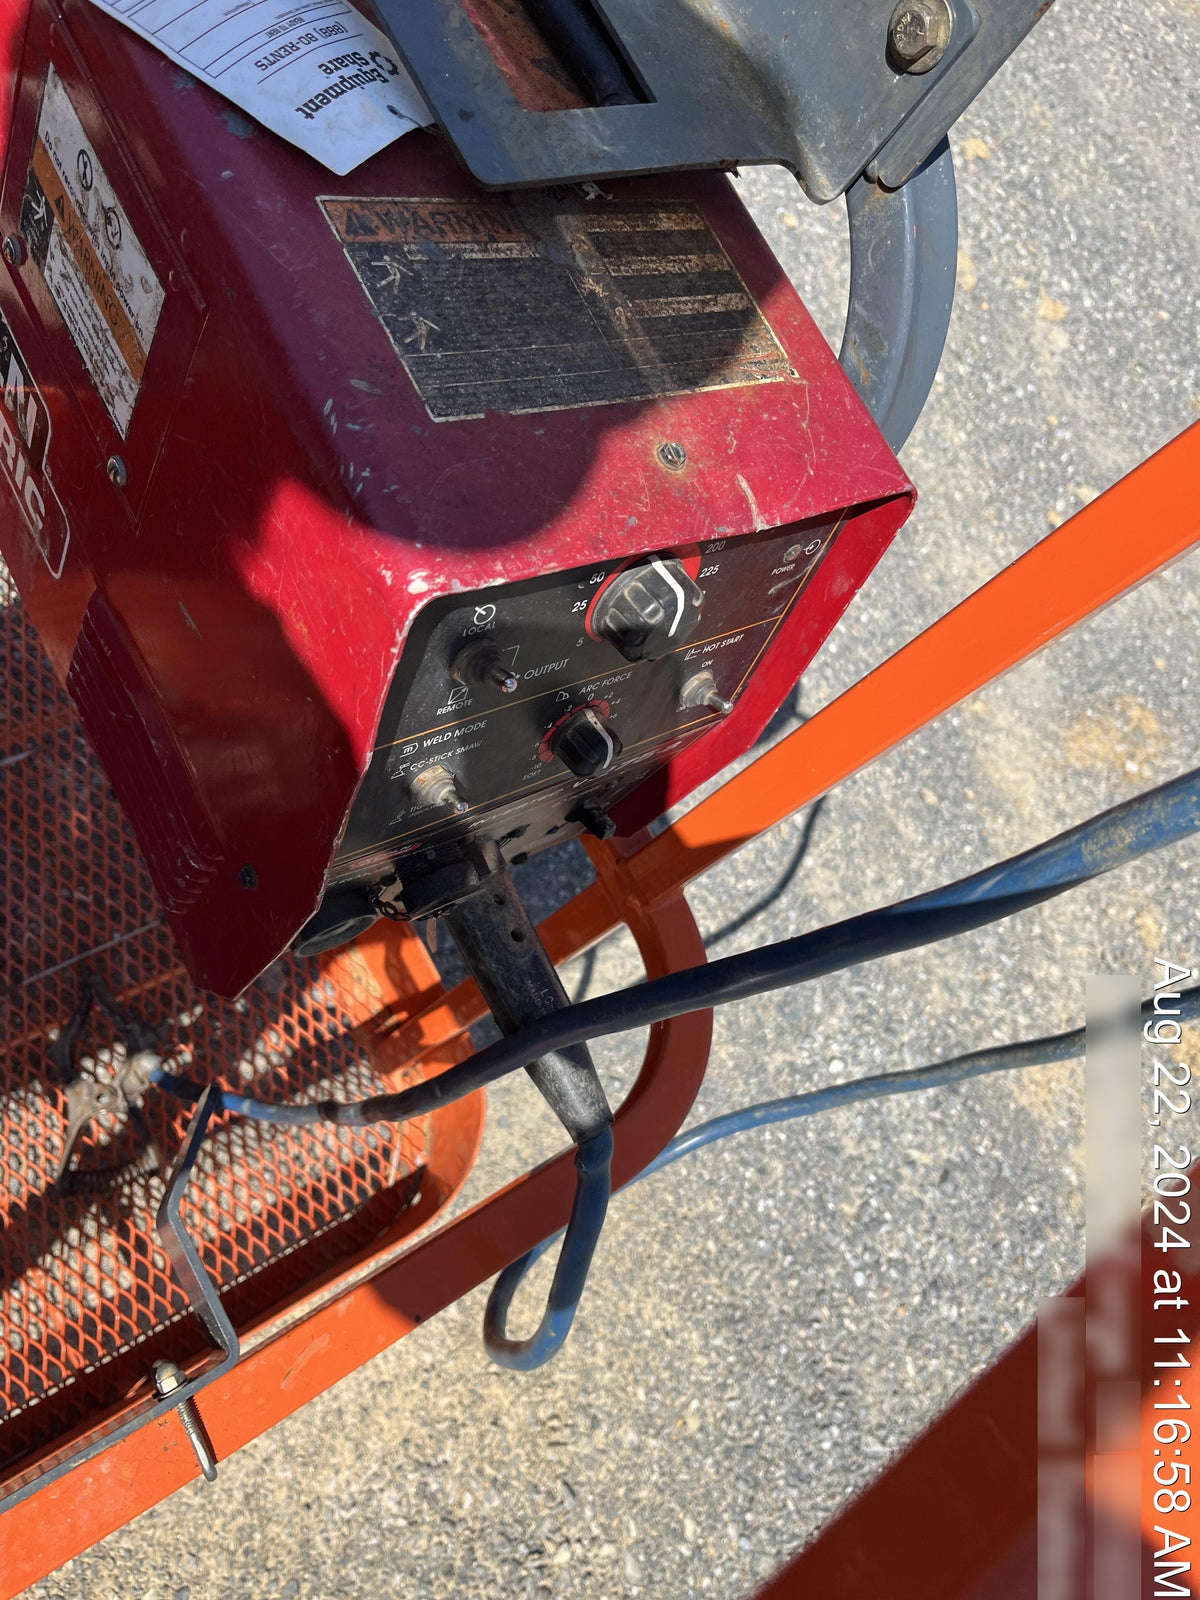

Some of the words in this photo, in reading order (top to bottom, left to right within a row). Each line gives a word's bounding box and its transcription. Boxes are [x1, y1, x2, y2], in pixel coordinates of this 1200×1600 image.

[313, 21, 349, 39] (888)
[254, 33, 319, 71] 80-RENTS
[317, 51, 370, 75] Share
[294, 68, 390, 120] Equipment
[705, 541, 726, 554] 200
[589, 571, 606, 585] 50
[699, 564, 720, 578] 225
[771, 563, 796, 576] POWER
[571, 600, 588, 613] 25
[462, 621, 496, 637] LOCAL
[576, 637, 584, 647] 5
[702, 642, 720, 654] HOT
[721, 634, 745, 648] START
[523, 658, 570, 680] OUTPUT
[701, 659, 714, 668] ON
[579, 682, 600, 695] ARC
[601, 671, 633, 688] FORCE
[436, 699, 474, 716] REMOTE
[423, 732, 452, 748] WELD
[454, 719, 488, 738] MODE
[410, 750, 454, 771] CC-STICK
